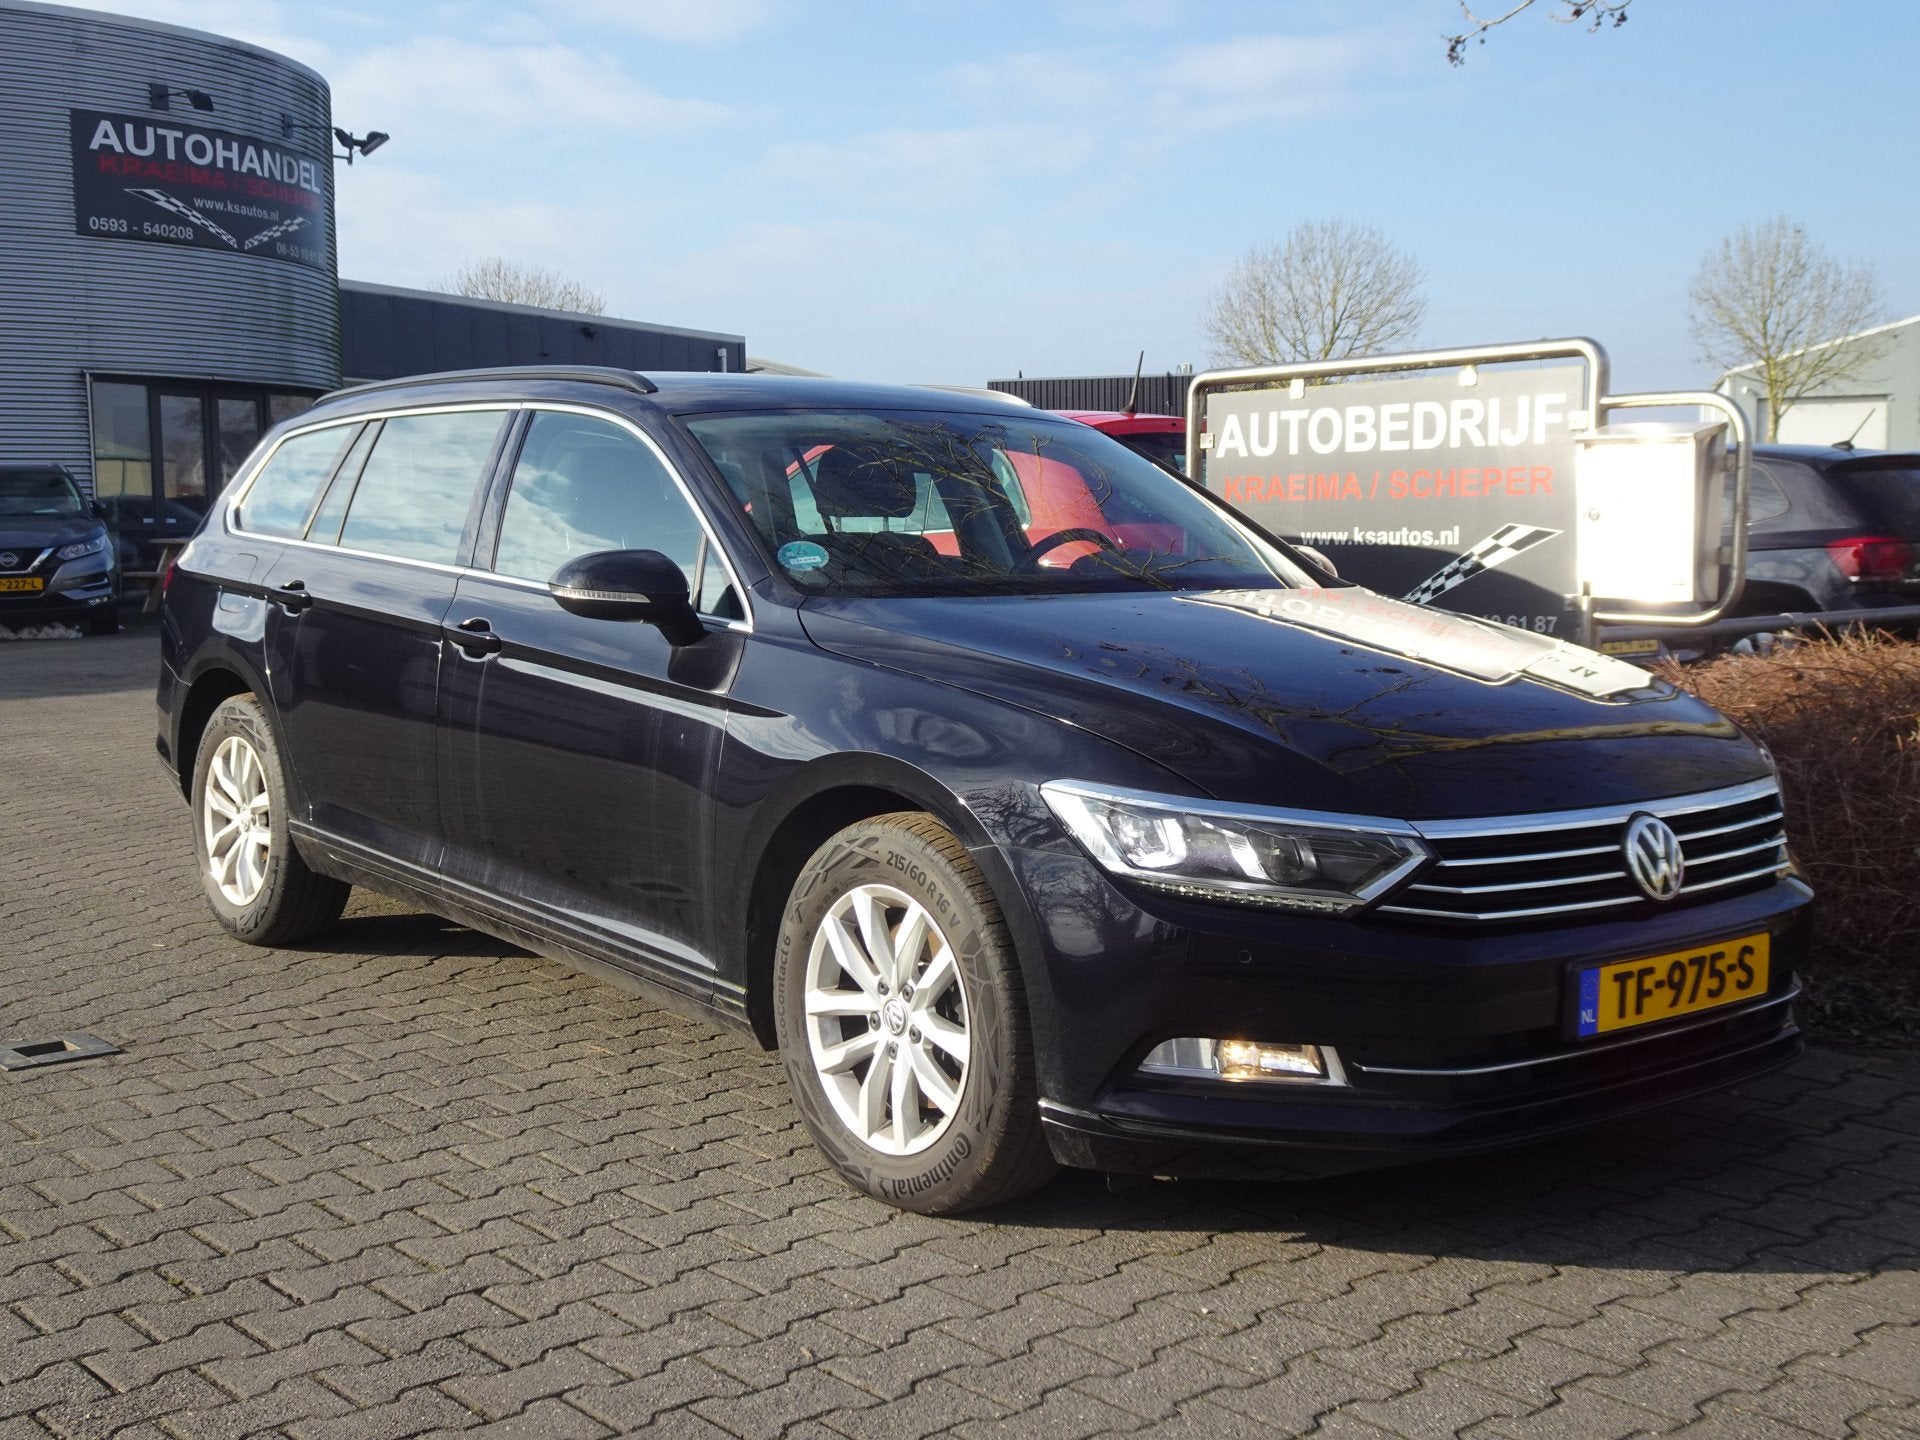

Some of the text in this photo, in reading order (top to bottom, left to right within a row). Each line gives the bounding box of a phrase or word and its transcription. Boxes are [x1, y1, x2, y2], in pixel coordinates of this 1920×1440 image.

[89, 119, 320, 195] AUTOHANDEL
[98, 154, 227, 192] KRAEIMA
[89, 216, 128, 232] 0593
[143, 222, 194, 240] 540208
[193, 198, 279, 221] www.ksautos.nl
[1215, 392, 1568, 459] AUTOBEDRIJF
[1223, 465, 1556, 503] KRAEIMA / SCHEPER
[1300, 525, 1461, 547] www.ksautos.nl
[0, 579, 38, 591] -227-L
[1535, 615, 1559, 633] 87
[886, 850, 961, 928] 215/60 R 16 V
[1613, 944, 1755, 1020] TF-975-S
[1581, 1009, 1596, 1025] NL
[892, 1131, 972, 1200] Continental
